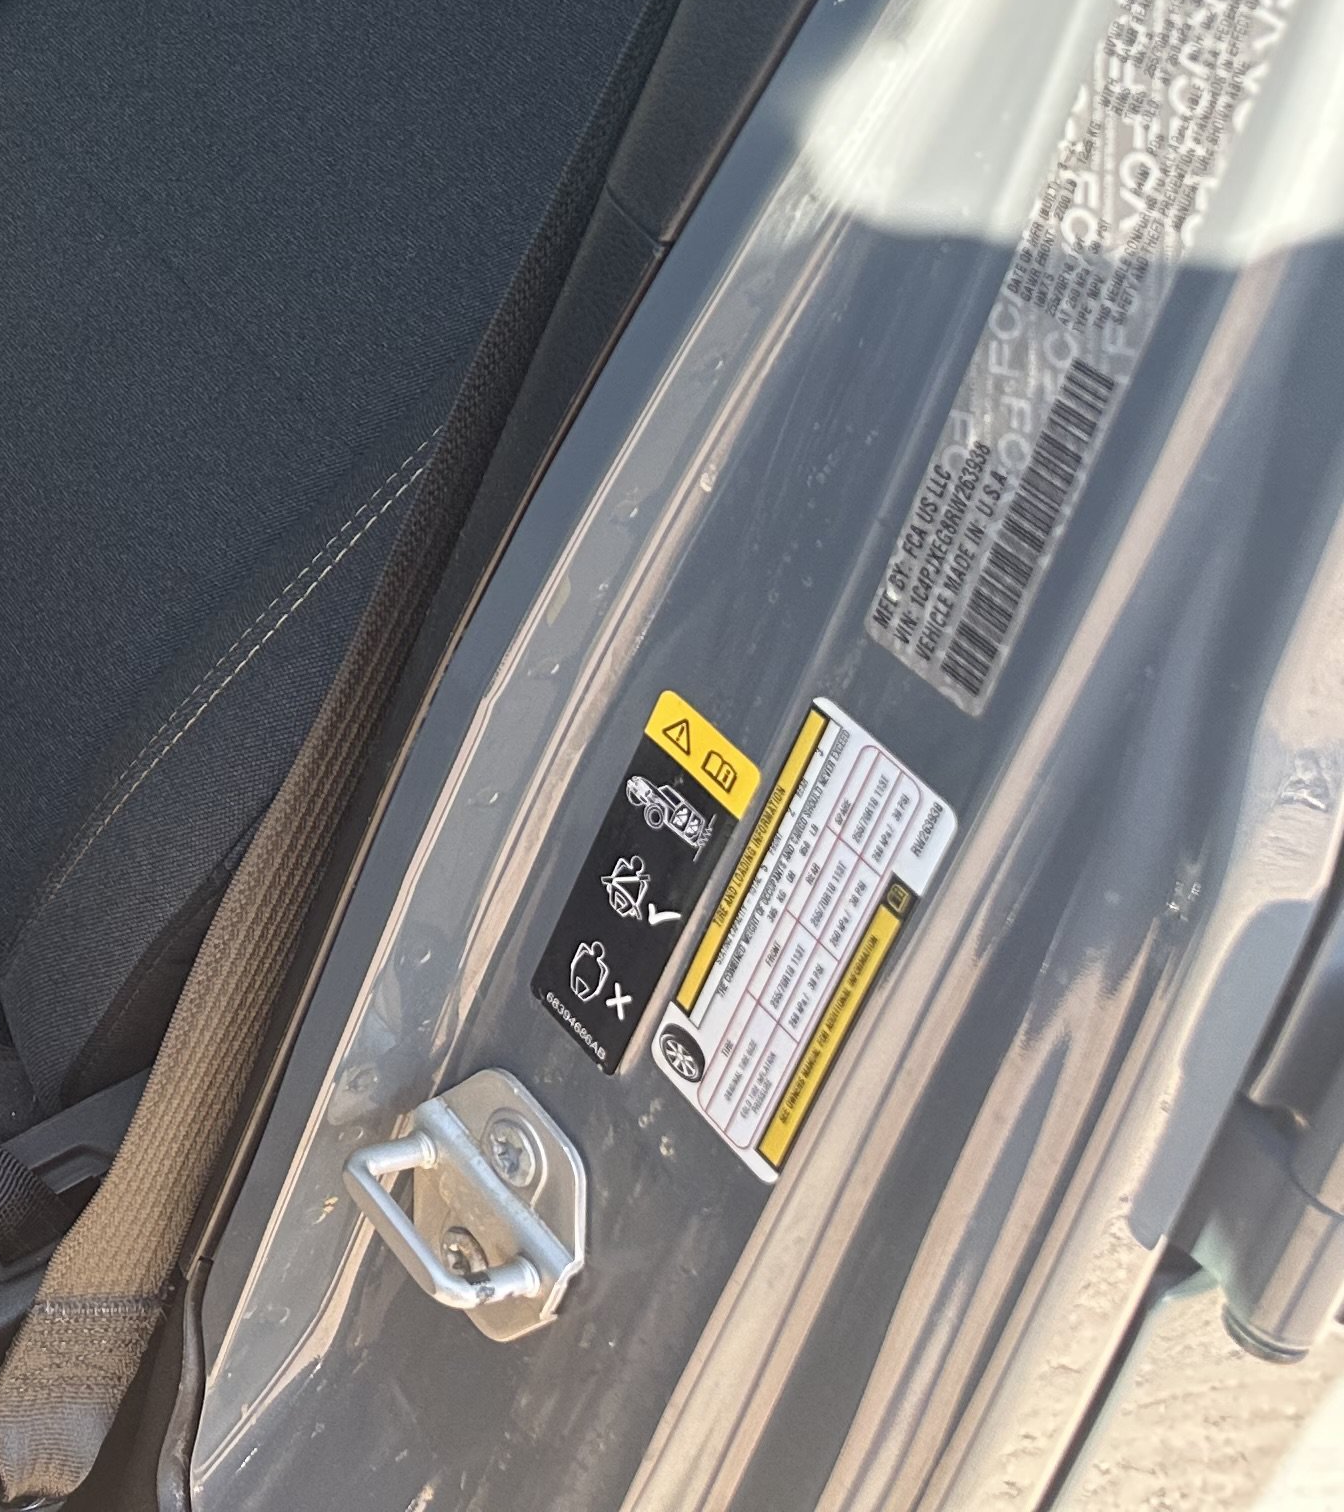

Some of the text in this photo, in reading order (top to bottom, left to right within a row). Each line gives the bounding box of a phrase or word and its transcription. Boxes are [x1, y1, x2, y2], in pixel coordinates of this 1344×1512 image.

[1006, 264, 1026, 294] DATE
[1019, 267, 1040, 302] GAWR
[1092, 303, 1112, 330] THIS
[1103, 256, 1131, 303] VEHICLE
[1111, 282, 1139, 325] SAFETY
[1129, 254, 1151, 281] AND
[915, 497, 937, 524] US
[925, 463, 952, 498] LLC
[894, 439, 992, 646] VIN: 1C4PJXEG8RW263938
[901, 524, 926, 559] FCA
[915, 592, 954, 663] VEHICLE
[942, 542, 976, 596] MADE
[712, 782, 786, 929] TIRE AND LOADING INFORMATION
[909, 799, 944, 858] RW263938
[716, 979, 728, 998] THE
[722, 941, 746, 984] COMBINED
[740, 913, 760, 946] WEIGHT
[781, 842, 795, 863] AND
[790, 815, 808, 846] CARGO
[802, 783, 824, 820] SHOULD
[829, 727, 851, 762] EXCEED
[764, 938, 782, 968] FRONT
[544, 989, 607, 1062] 68394686AB
